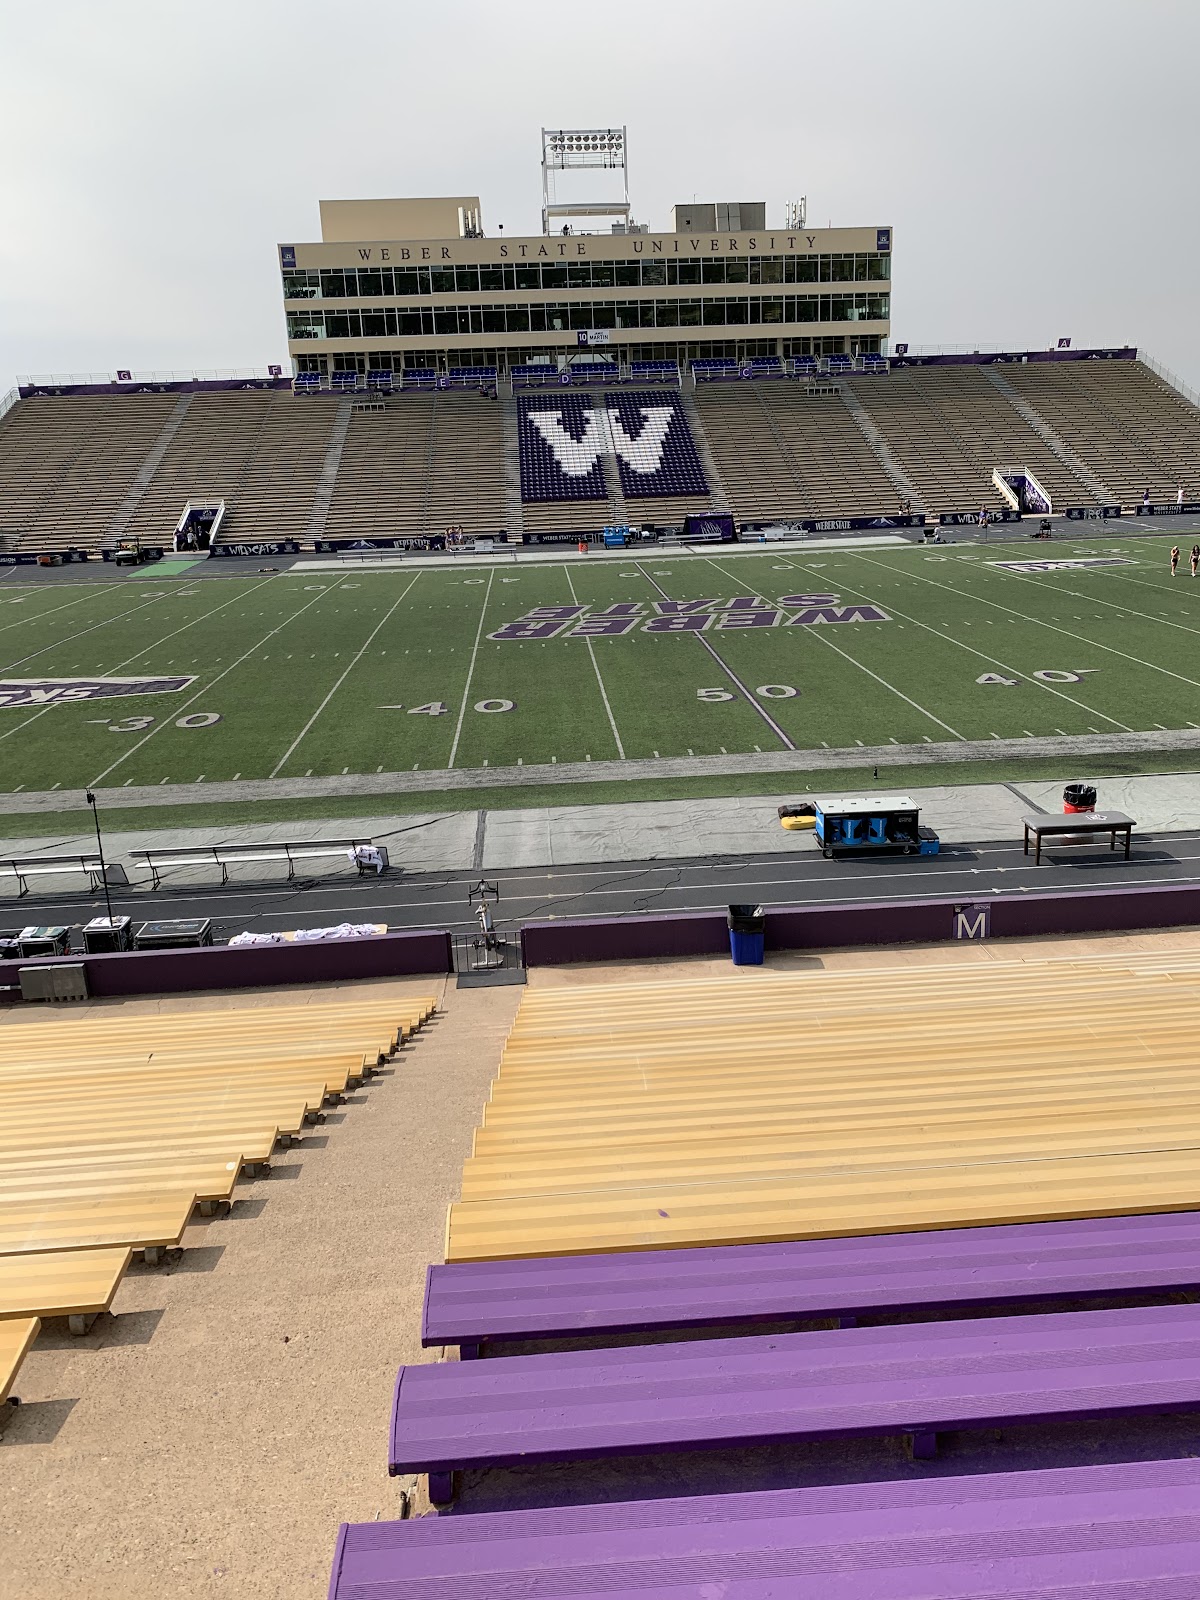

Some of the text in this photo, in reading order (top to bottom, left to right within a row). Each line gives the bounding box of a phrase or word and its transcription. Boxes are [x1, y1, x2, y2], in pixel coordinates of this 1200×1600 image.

[358, 236, 817, 261] WEBER STATE UNIVERSITY
[578, 333, 587, 341] 10
[898, 344, 905, 353] B
[1060, 339, 1068, 348] A
[121, 371, 129, 381] G
[272, 366, 279, 376] F
[742, 367, 750, 377] C
[439, 378, 447, 388] E
[561, 374, 569, 383] D
[228, 543, 279, 556] WILDCATS
[514, 593, 841, 622] STATE
[486, 604, 894, 640] WEBER
[957, 912, 986, 939] M
